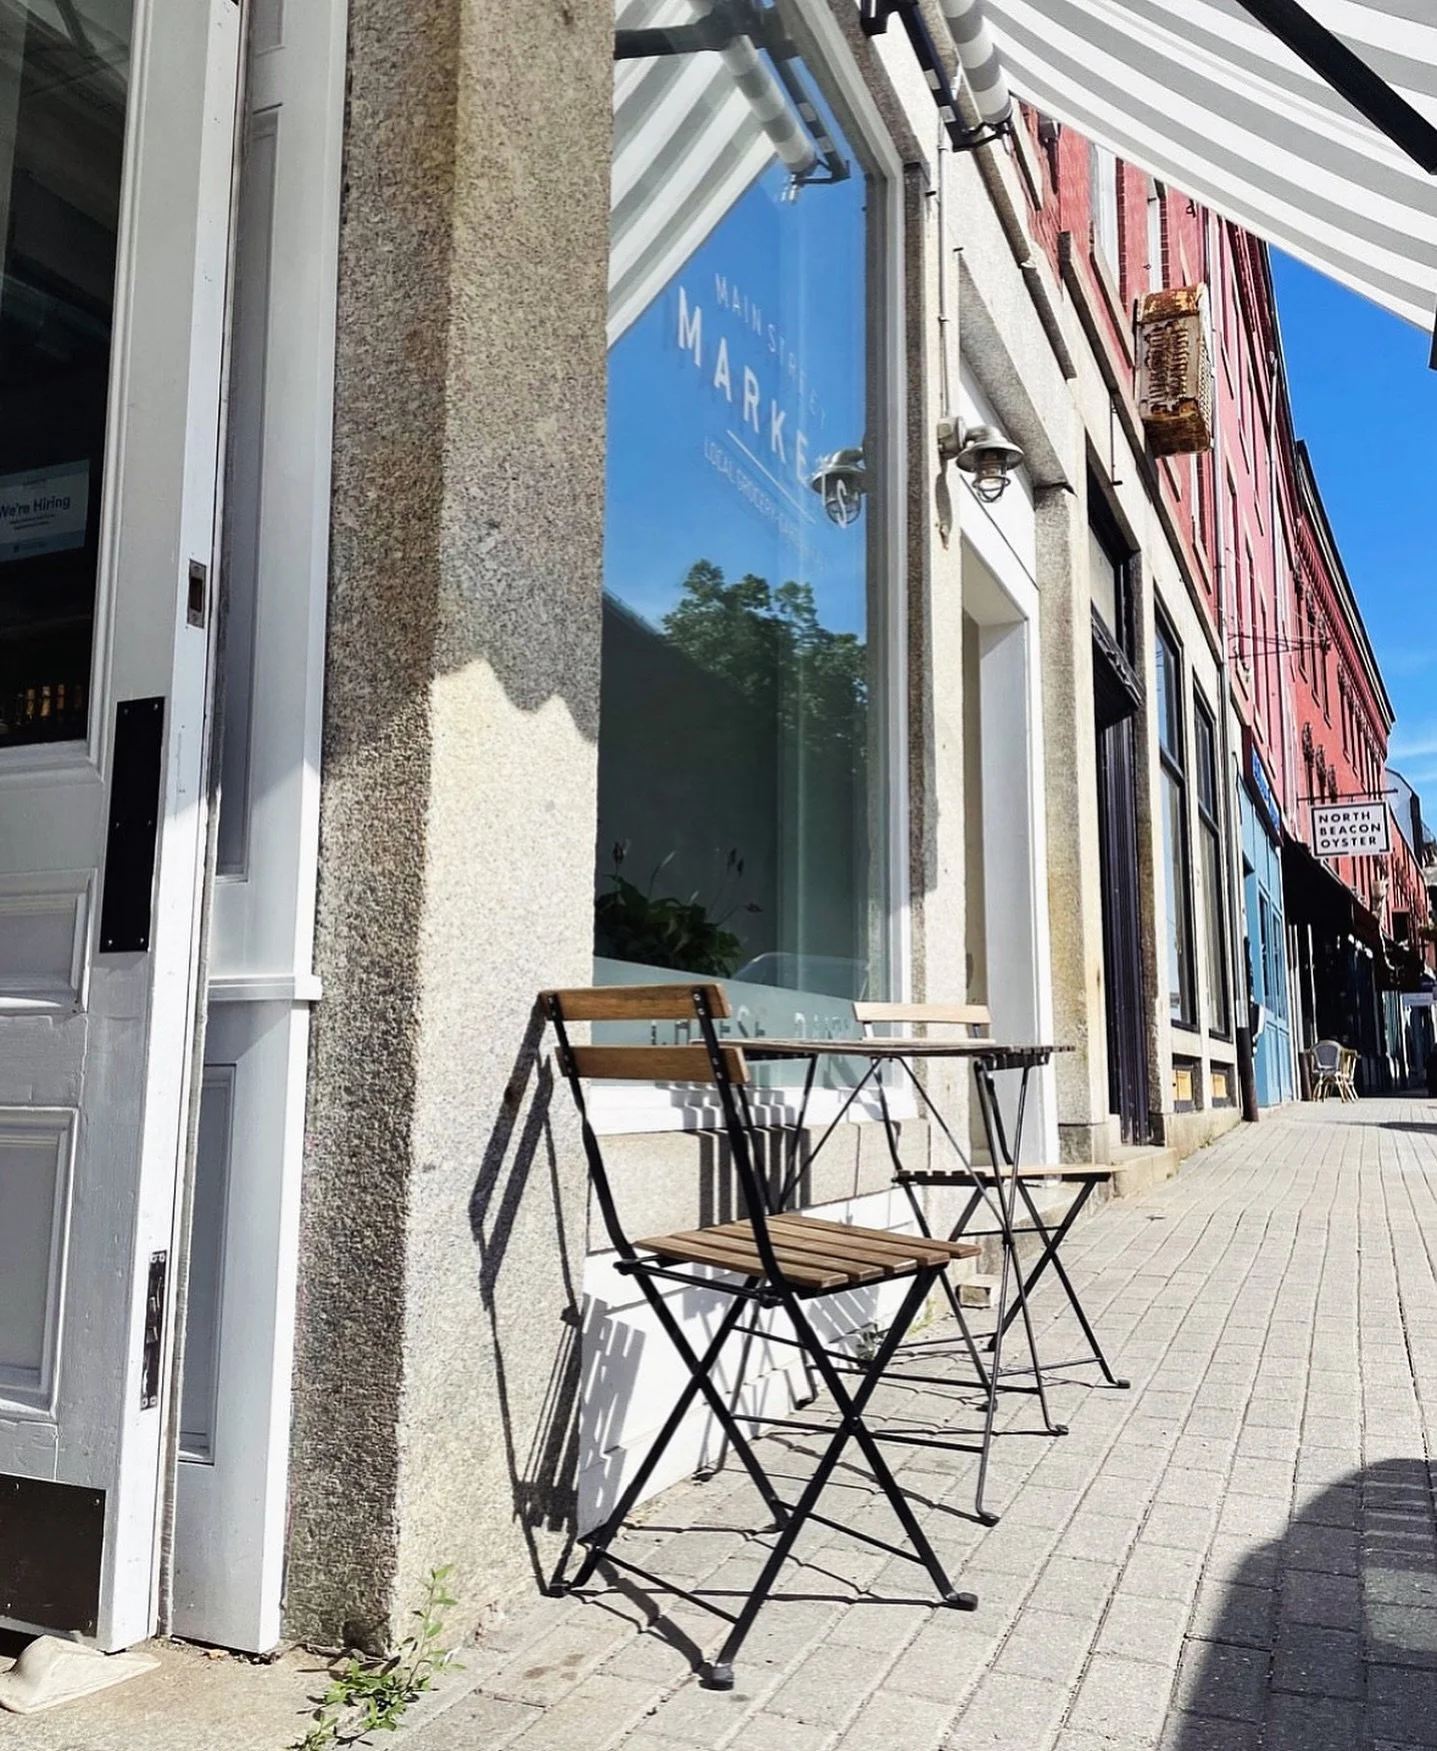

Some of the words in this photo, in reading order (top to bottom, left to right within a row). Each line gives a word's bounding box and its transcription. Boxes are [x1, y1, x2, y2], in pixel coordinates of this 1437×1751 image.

[714, 272, 763, 336] MAIN
[0, 502, 31, 518] We're
[32, 495, 71, 512] Hiring
[1319, 811, 1370, 823] NORTH
[1320, 823, 1381, 836] BEACON
[1321, 836, 1376, 848] OYSTER
